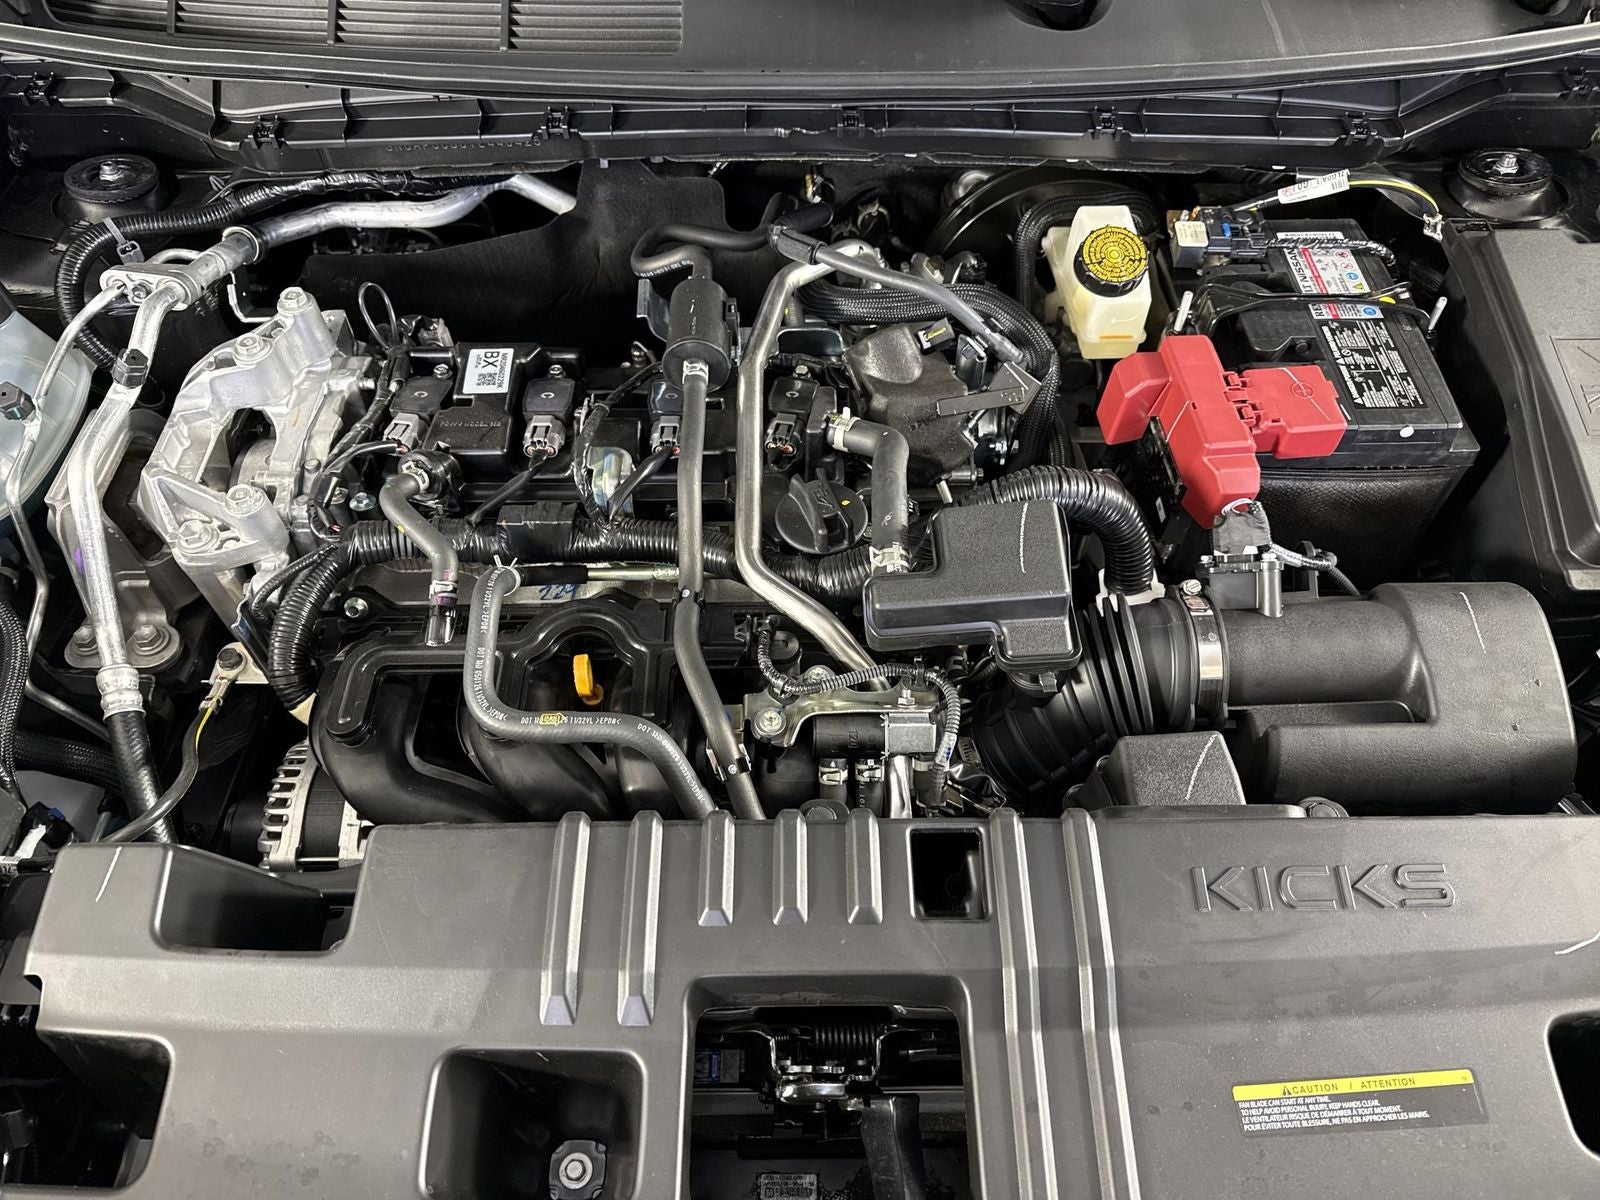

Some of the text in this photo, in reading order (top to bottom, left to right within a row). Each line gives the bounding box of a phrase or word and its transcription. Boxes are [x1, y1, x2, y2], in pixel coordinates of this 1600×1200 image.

[482, 351, 501, 369] BX
[1191, 863, 1456, 911] KICKS
[1292, 1083, 1339, 1095] CAUTION
[1361, 1077, 1416, 1090] ATTENTION
[1238, 1101, 1250, 1109] FAN
[1250, 1099, 1269, 1108] BLADE
[1268, 1098, 1280, 1107] CAN
[1280, 1097, 1298, 1106] START
[1297, 1097, 1305, 1105] AT
[1241, 1108, 1249, 1117] TO
[1248, 1107, 1264, 1116] HELP
[1263, 1106, 1281, 1115] AVOID
[1280, 1104, 1309, 1114] PERSONAL
[1328, 1102, 1342, 1110] KEEP
[1341, 1100, 1361, 1109] HANDS
[1361, 1099, 1381, 1107] CLEAR.
[1242, 1115, 1250, 1124] LE
[1249, 1113, 1289, 1124] VENTILATEUR
[1288, 1111, 1311, 1121] RISQUE
[1310, 1111, 1320, 1119] DE
[1357, 1106, 1374, 1115] TOUT
[1373, 1104, 1403, 1114] MOMENT.
[1243, 1123, 1262, 1132] POUR
[1280, 1119, 1302, 1129] TOUTE
[1330, 1116, 1342, 1125] NE
[1340, 1115, 1353, 1124] PAS
[1352, 1115, 1362, 1124] EN
[1361, 1112, 1398, 1122] APPROCHER
[1397, 1111, 1409, 1120] LES
[1408, 1110, 1430, 1119] MAINS.
